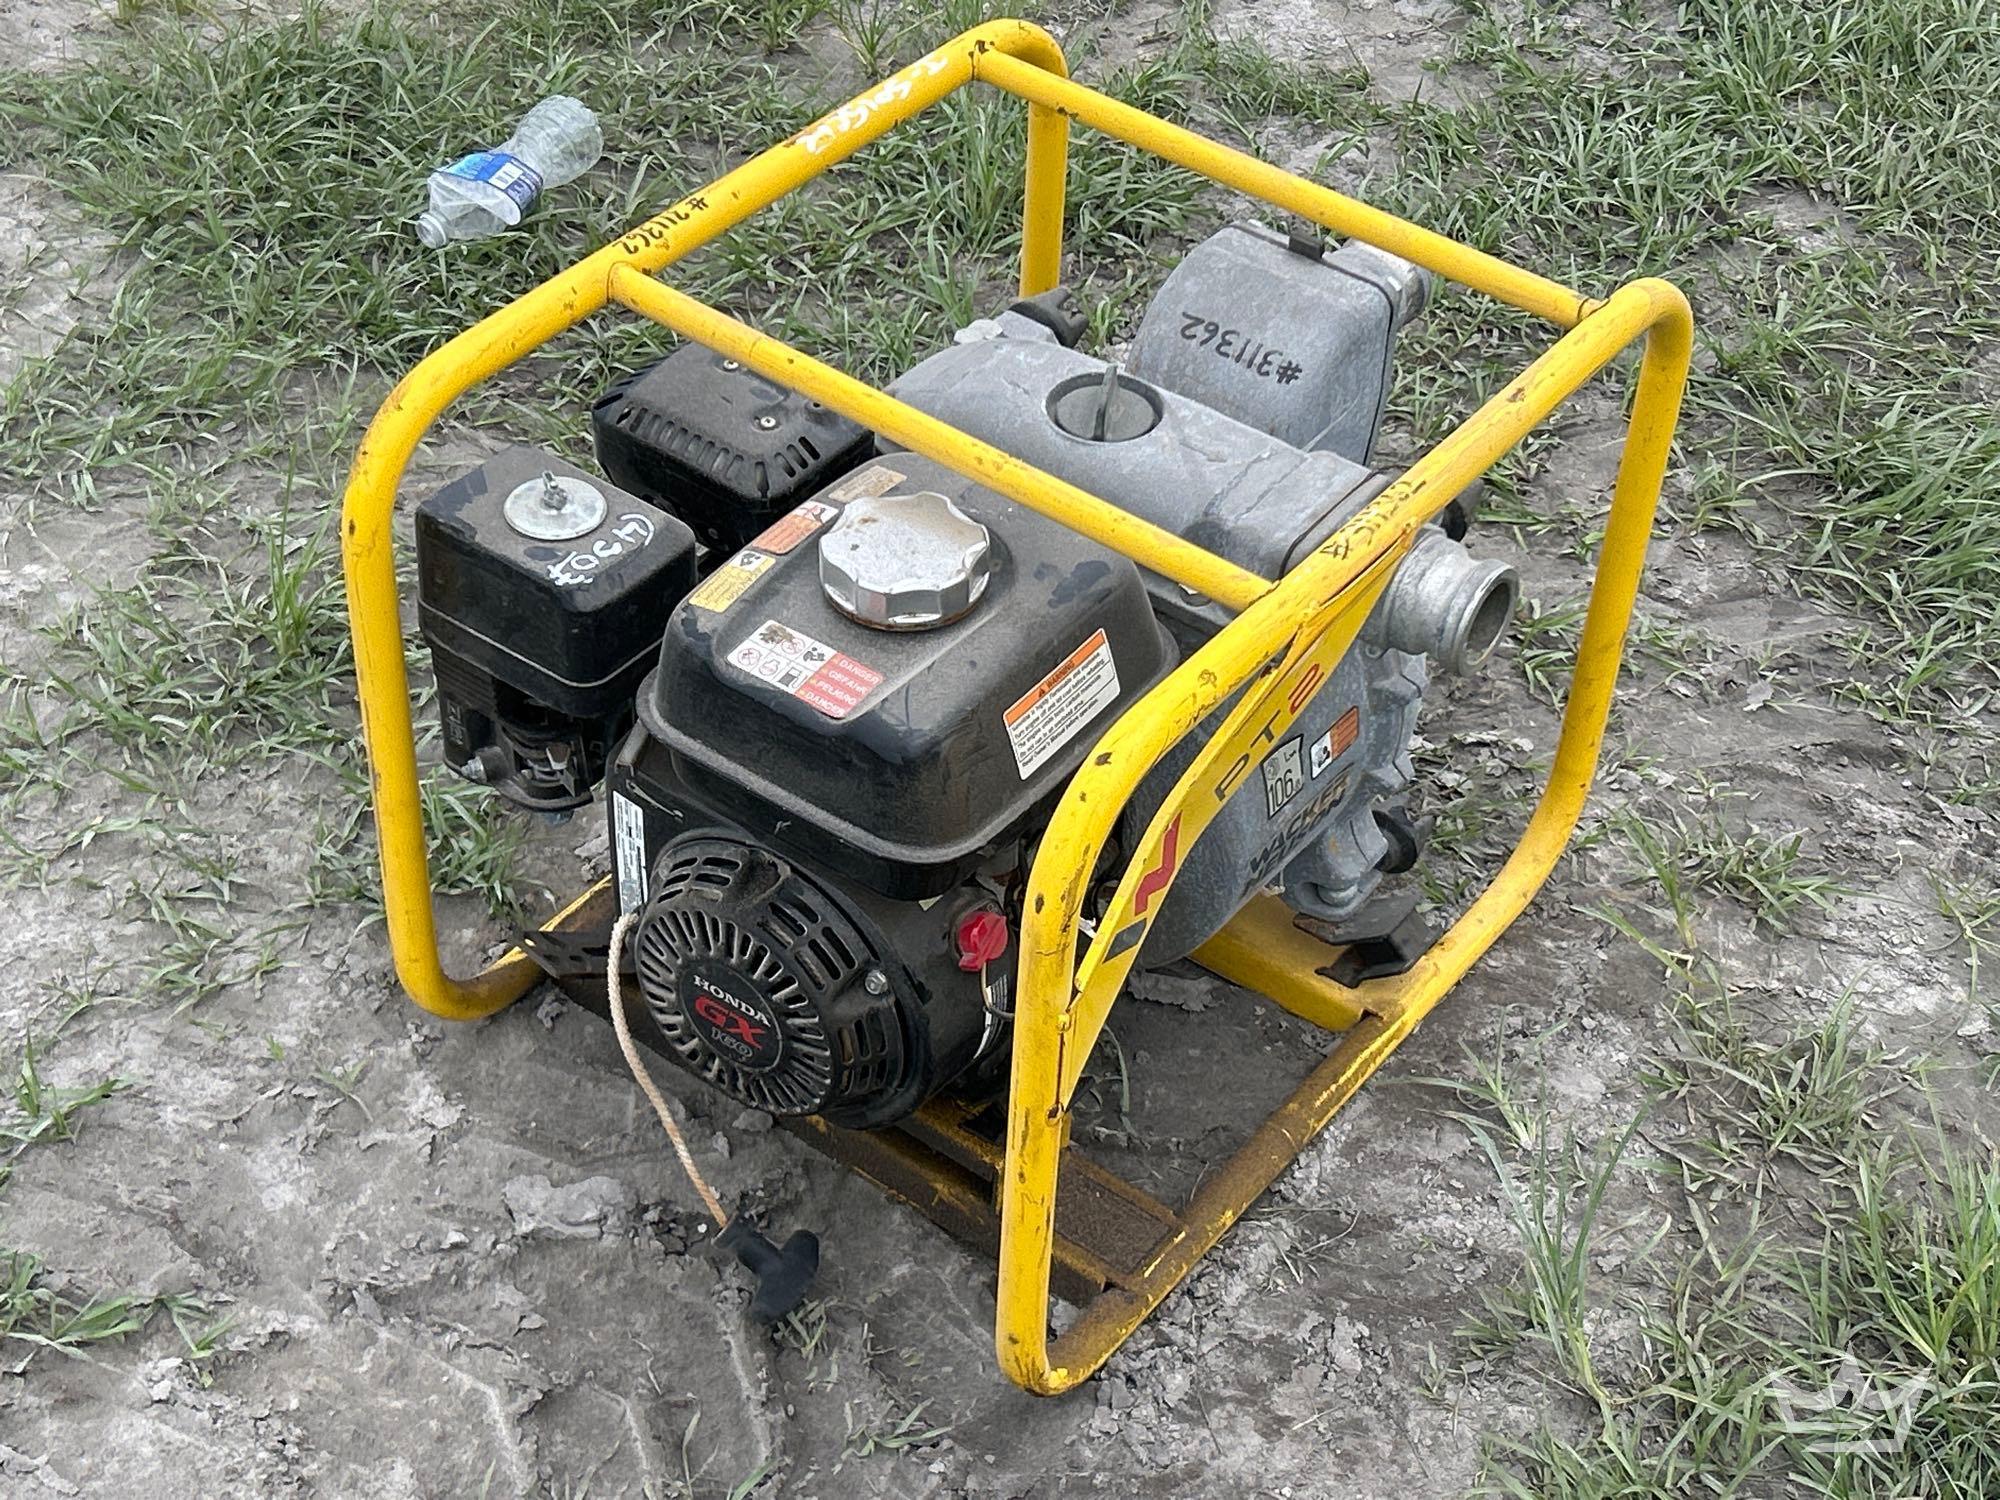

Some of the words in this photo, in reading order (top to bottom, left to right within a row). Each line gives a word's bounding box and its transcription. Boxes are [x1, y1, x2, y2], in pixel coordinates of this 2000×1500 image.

[1180, 312, 1302, 384] #311362
[839, 658, 884, 685] DANGER
[1046, 660, 1075, 688] WARNING
[1269, 769, 1294, 812] 106
[694, 975, 771, 1028] HONDA
[695, 995, 766, 1050] GX
